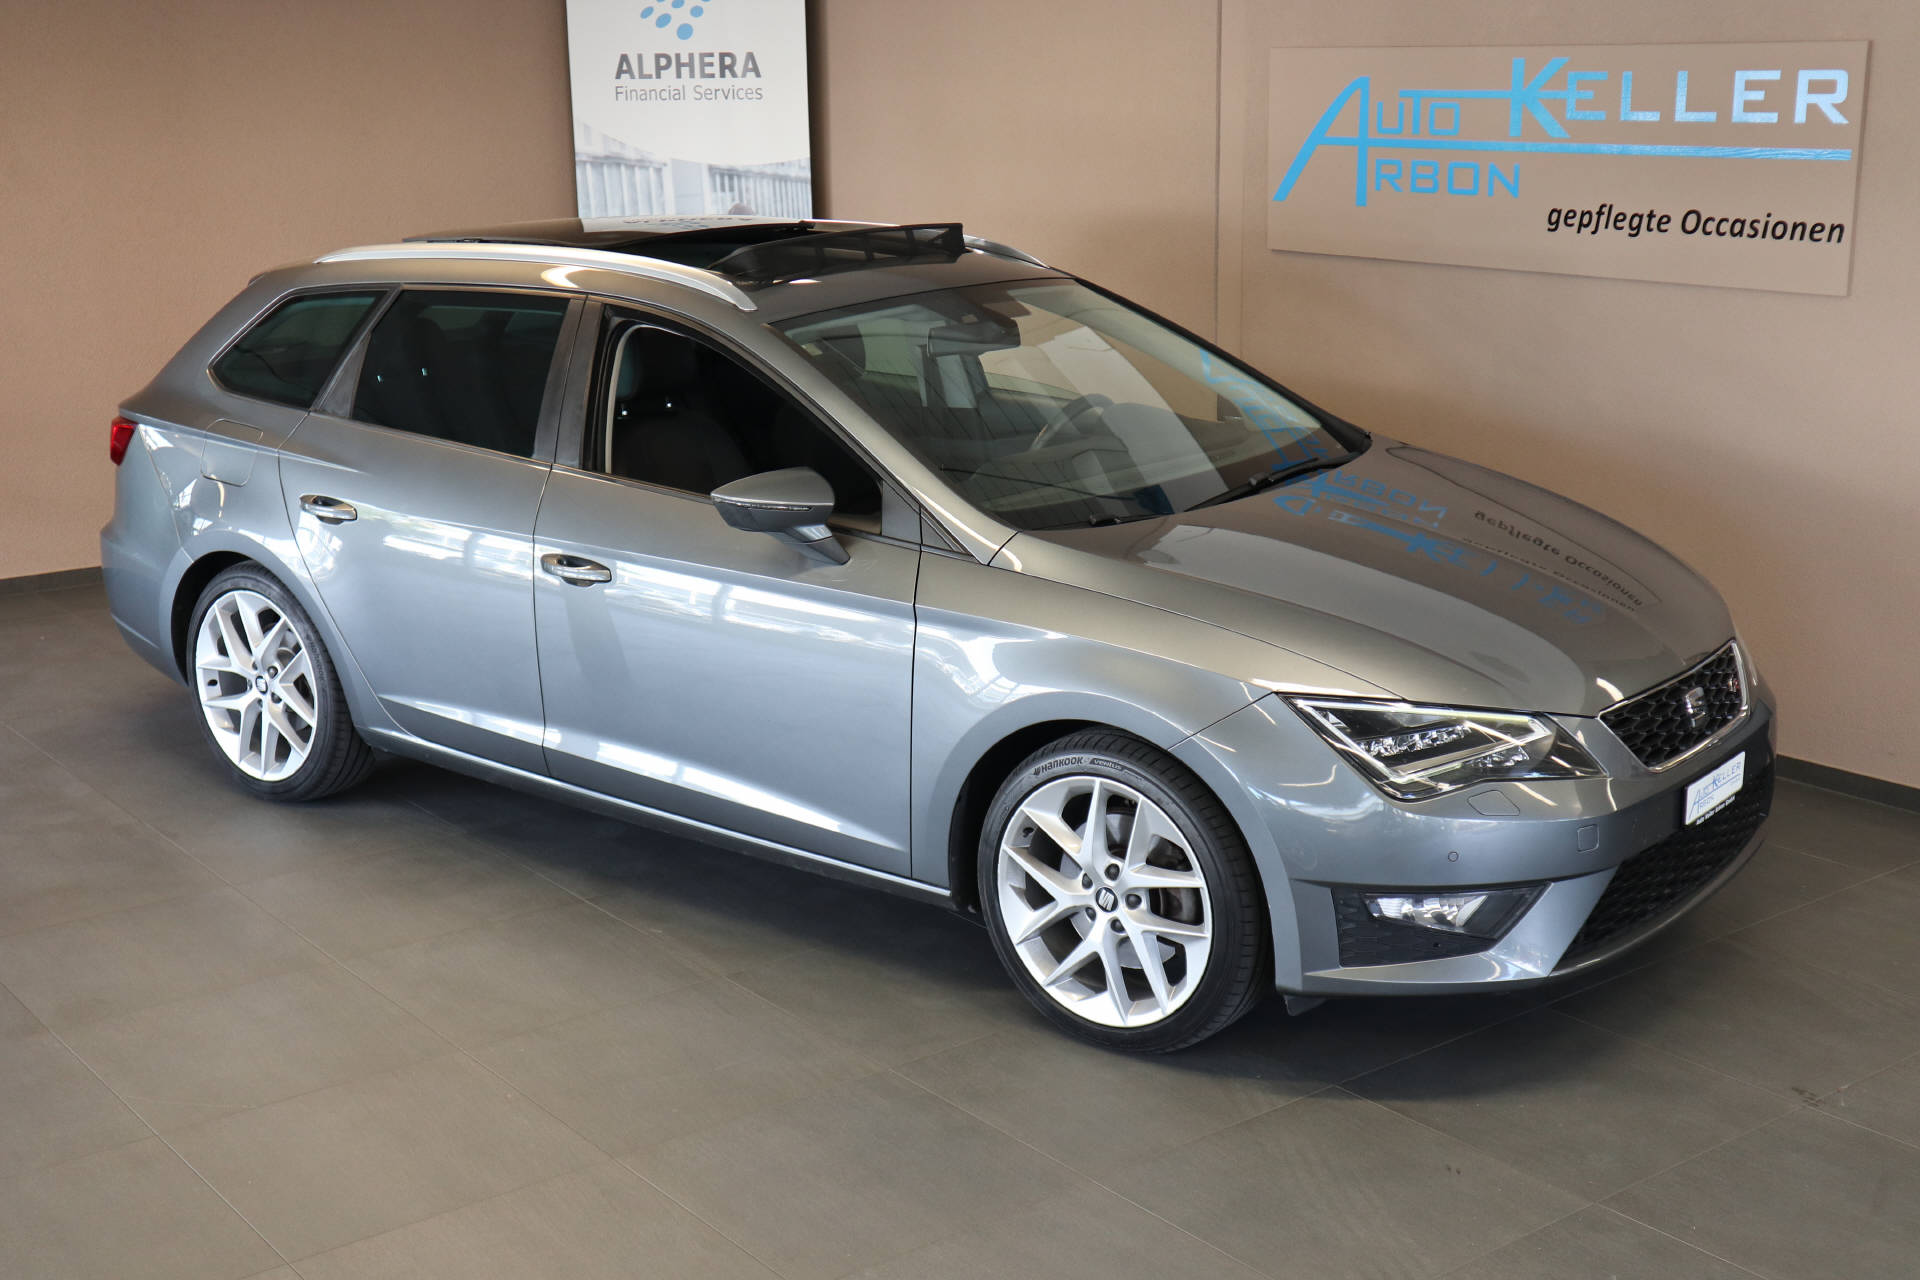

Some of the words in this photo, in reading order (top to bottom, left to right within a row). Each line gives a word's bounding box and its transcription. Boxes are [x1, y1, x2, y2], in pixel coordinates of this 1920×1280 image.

[615, 51, 762, 79] ALPHERA
[615, 84, 686, 101] Financial
[693, 84, 763, 101] Services
[1509, 56, 1849, 138] KELLER
[1546, 203, 1672, 239] gepflegte
[1681, 208, 1846, 244] Occasionen
